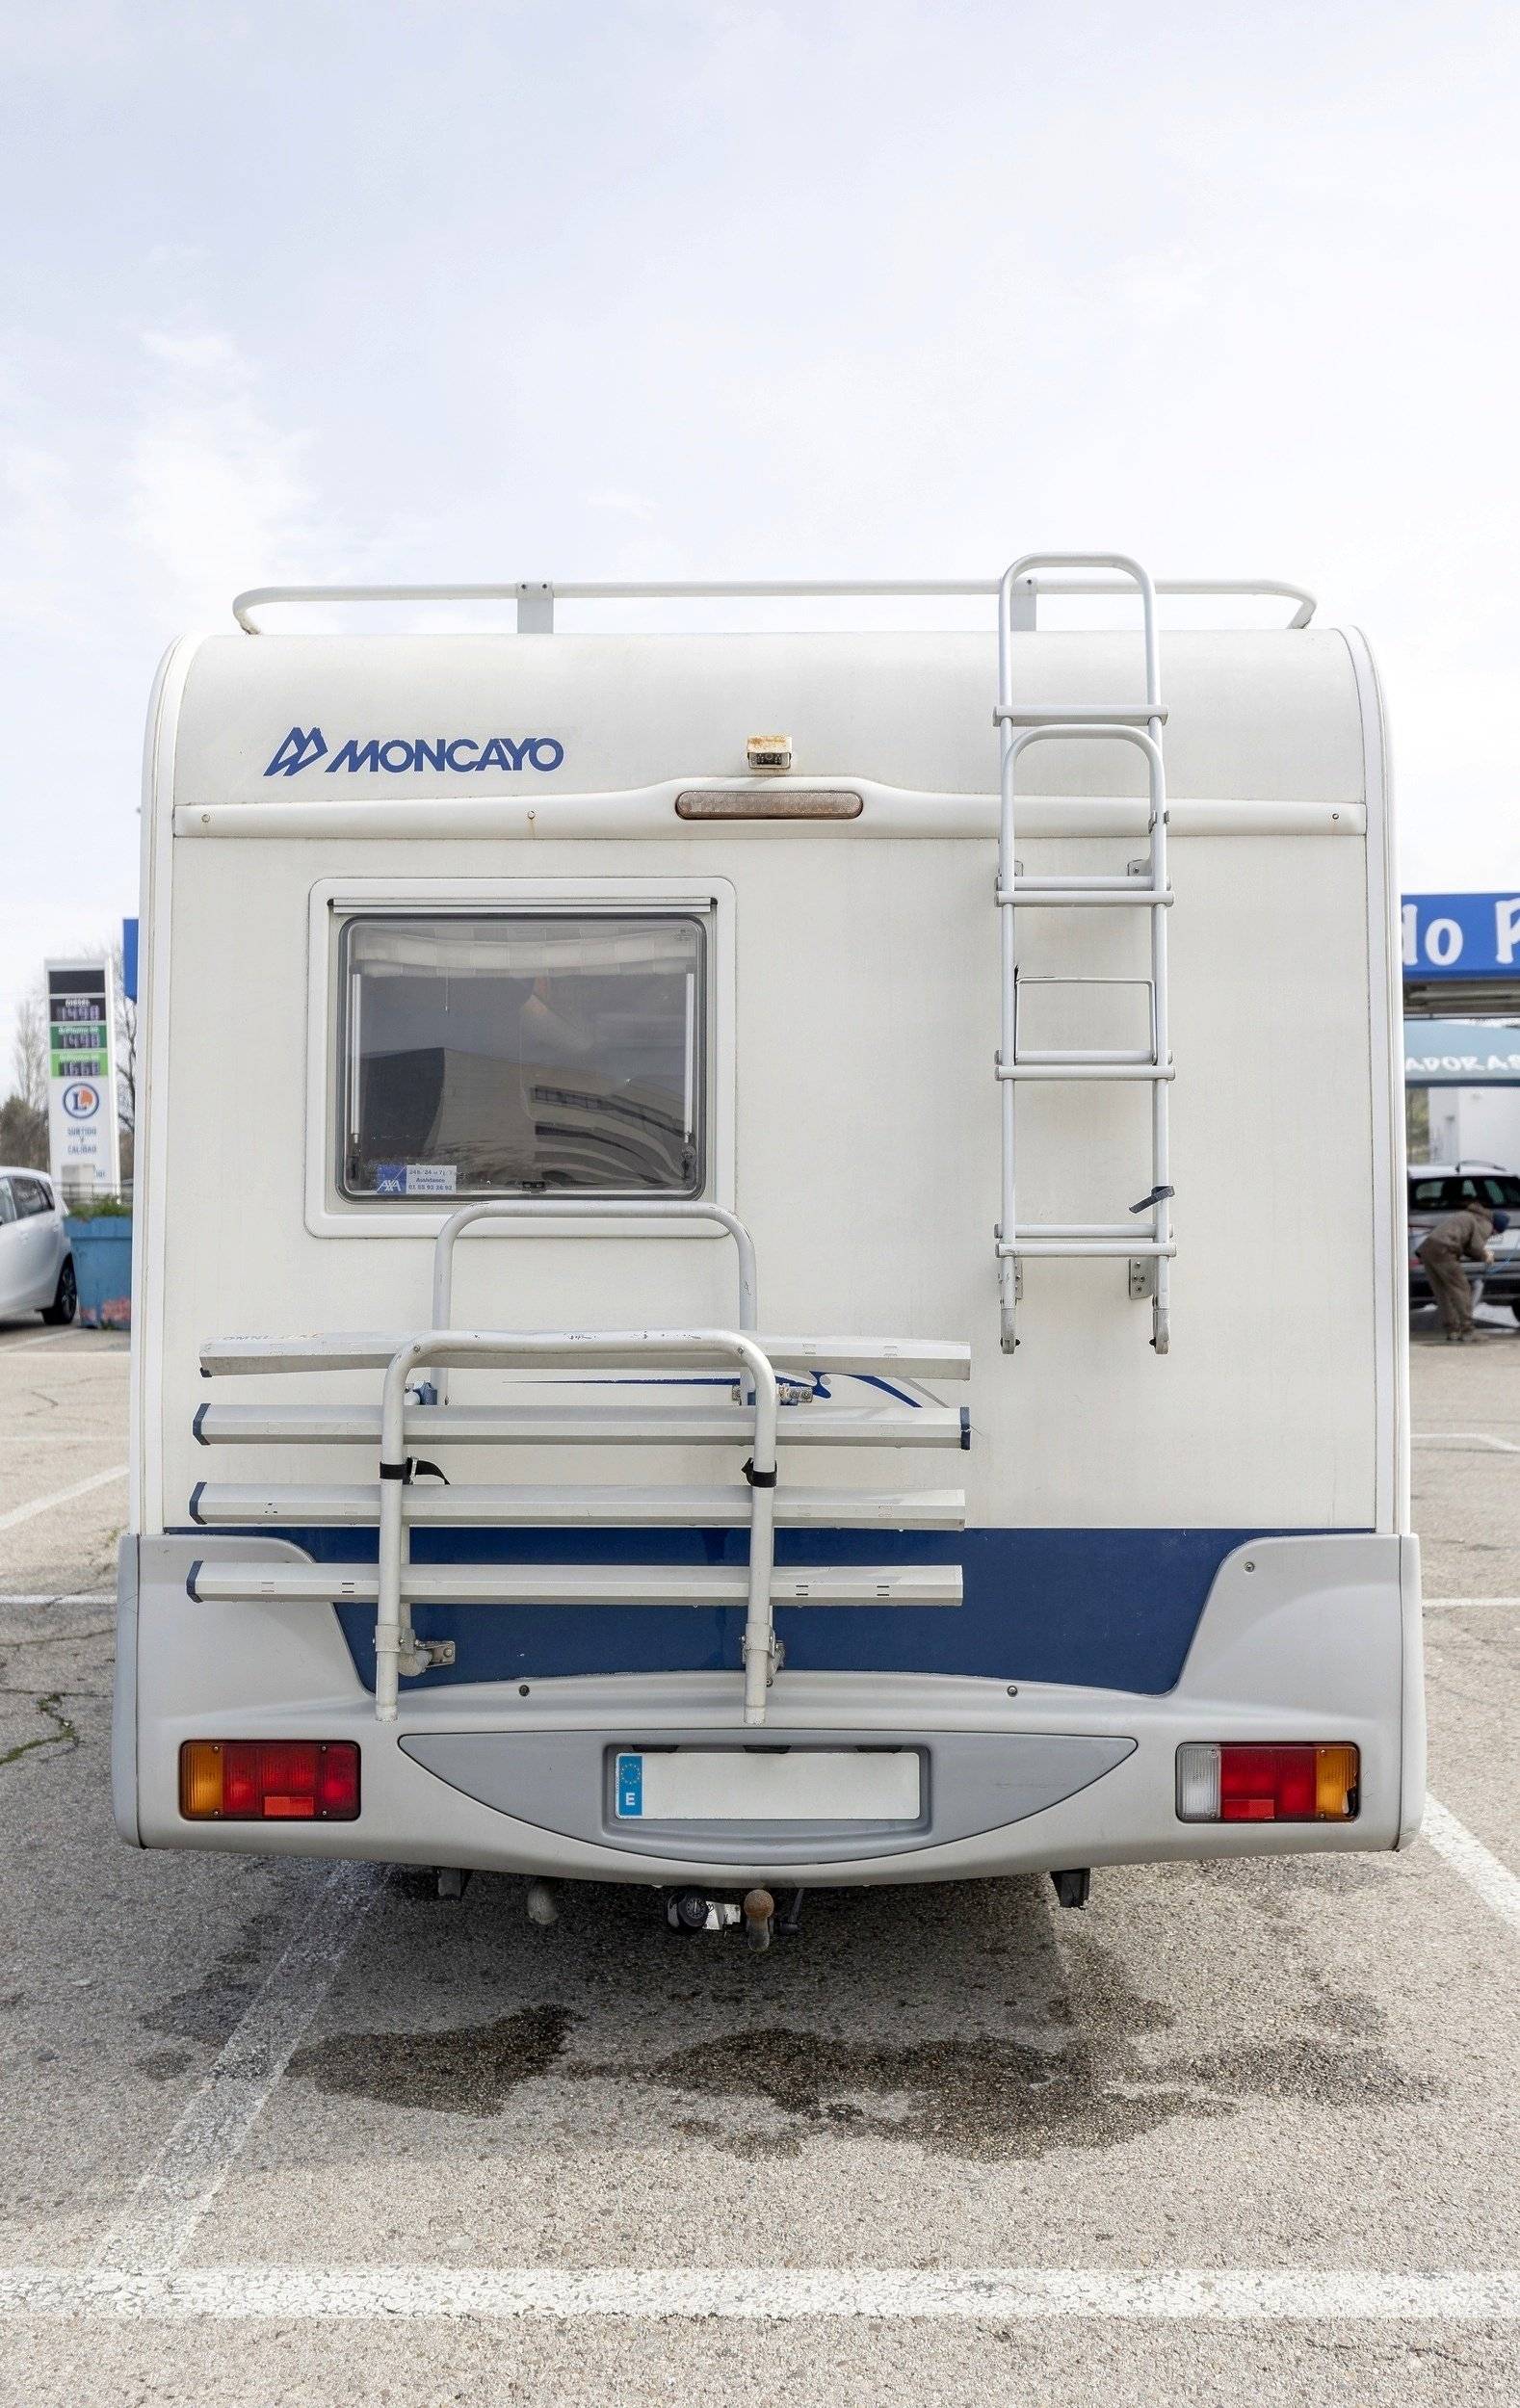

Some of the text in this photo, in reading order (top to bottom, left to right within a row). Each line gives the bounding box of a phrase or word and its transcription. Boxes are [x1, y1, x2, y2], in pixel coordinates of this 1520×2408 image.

[324, 737, 564, 773] MONCAYO
[377, 1179, 402, 1191] AXA
[626, 1793, 636, 1806] E
